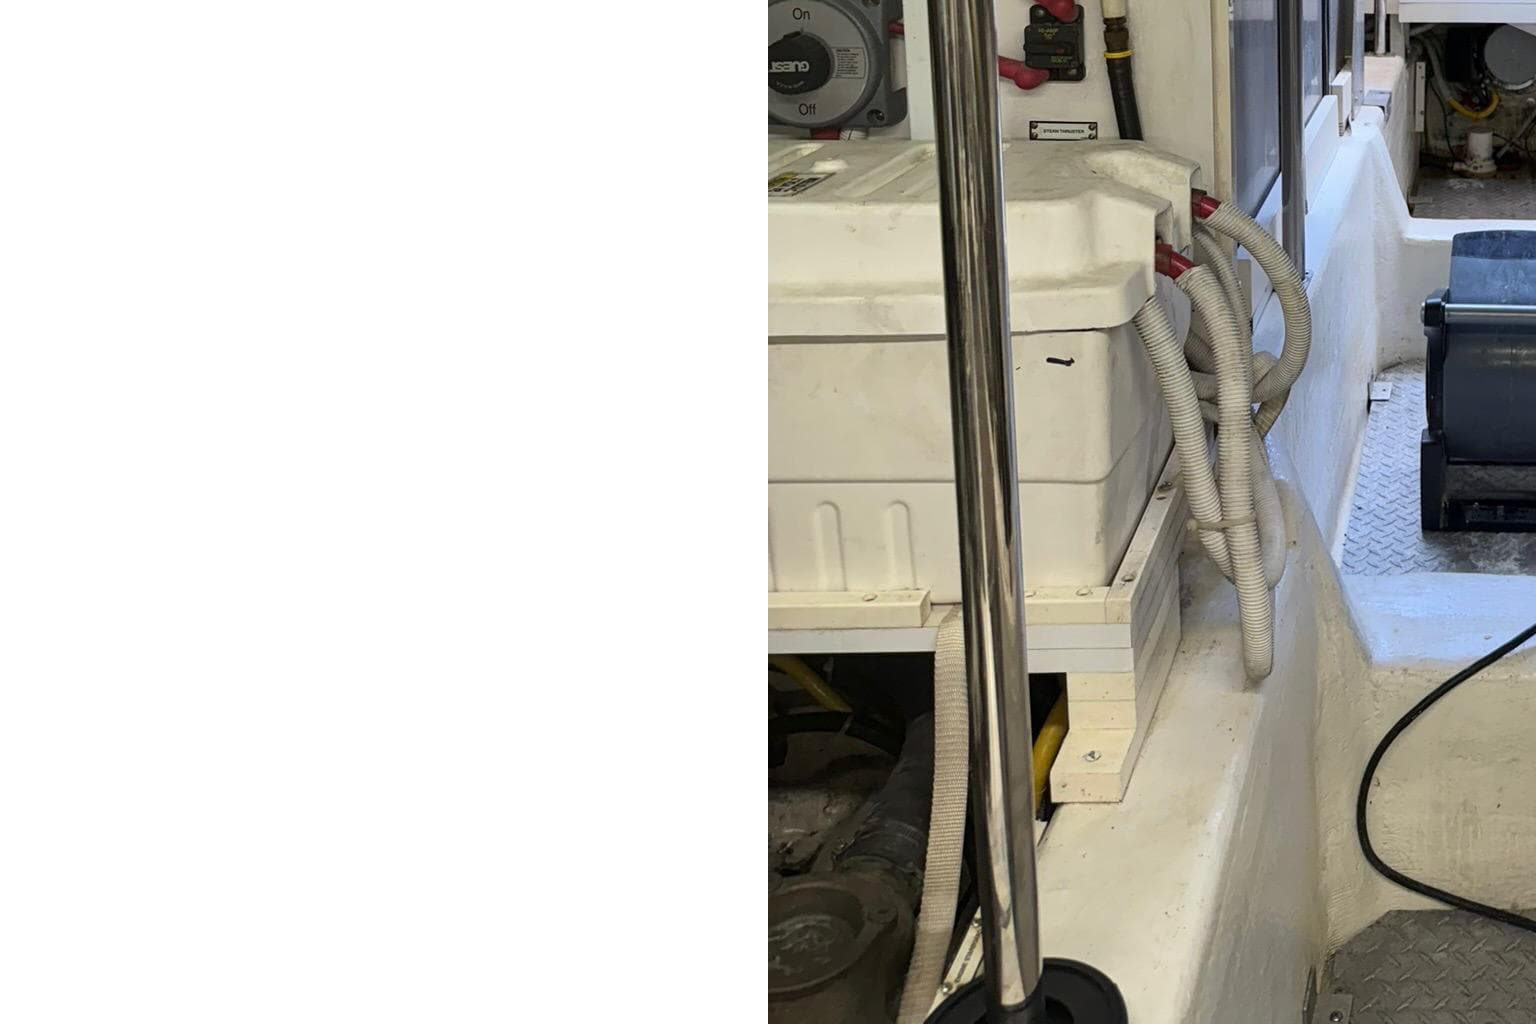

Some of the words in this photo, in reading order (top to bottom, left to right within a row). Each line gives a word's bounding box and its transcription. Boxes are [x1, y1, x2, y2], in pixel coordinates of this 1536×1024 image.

[792, 7, 811, 20] On
[768, 61, 810, 72] GUEST
[798, 103, 817, 115] Off
